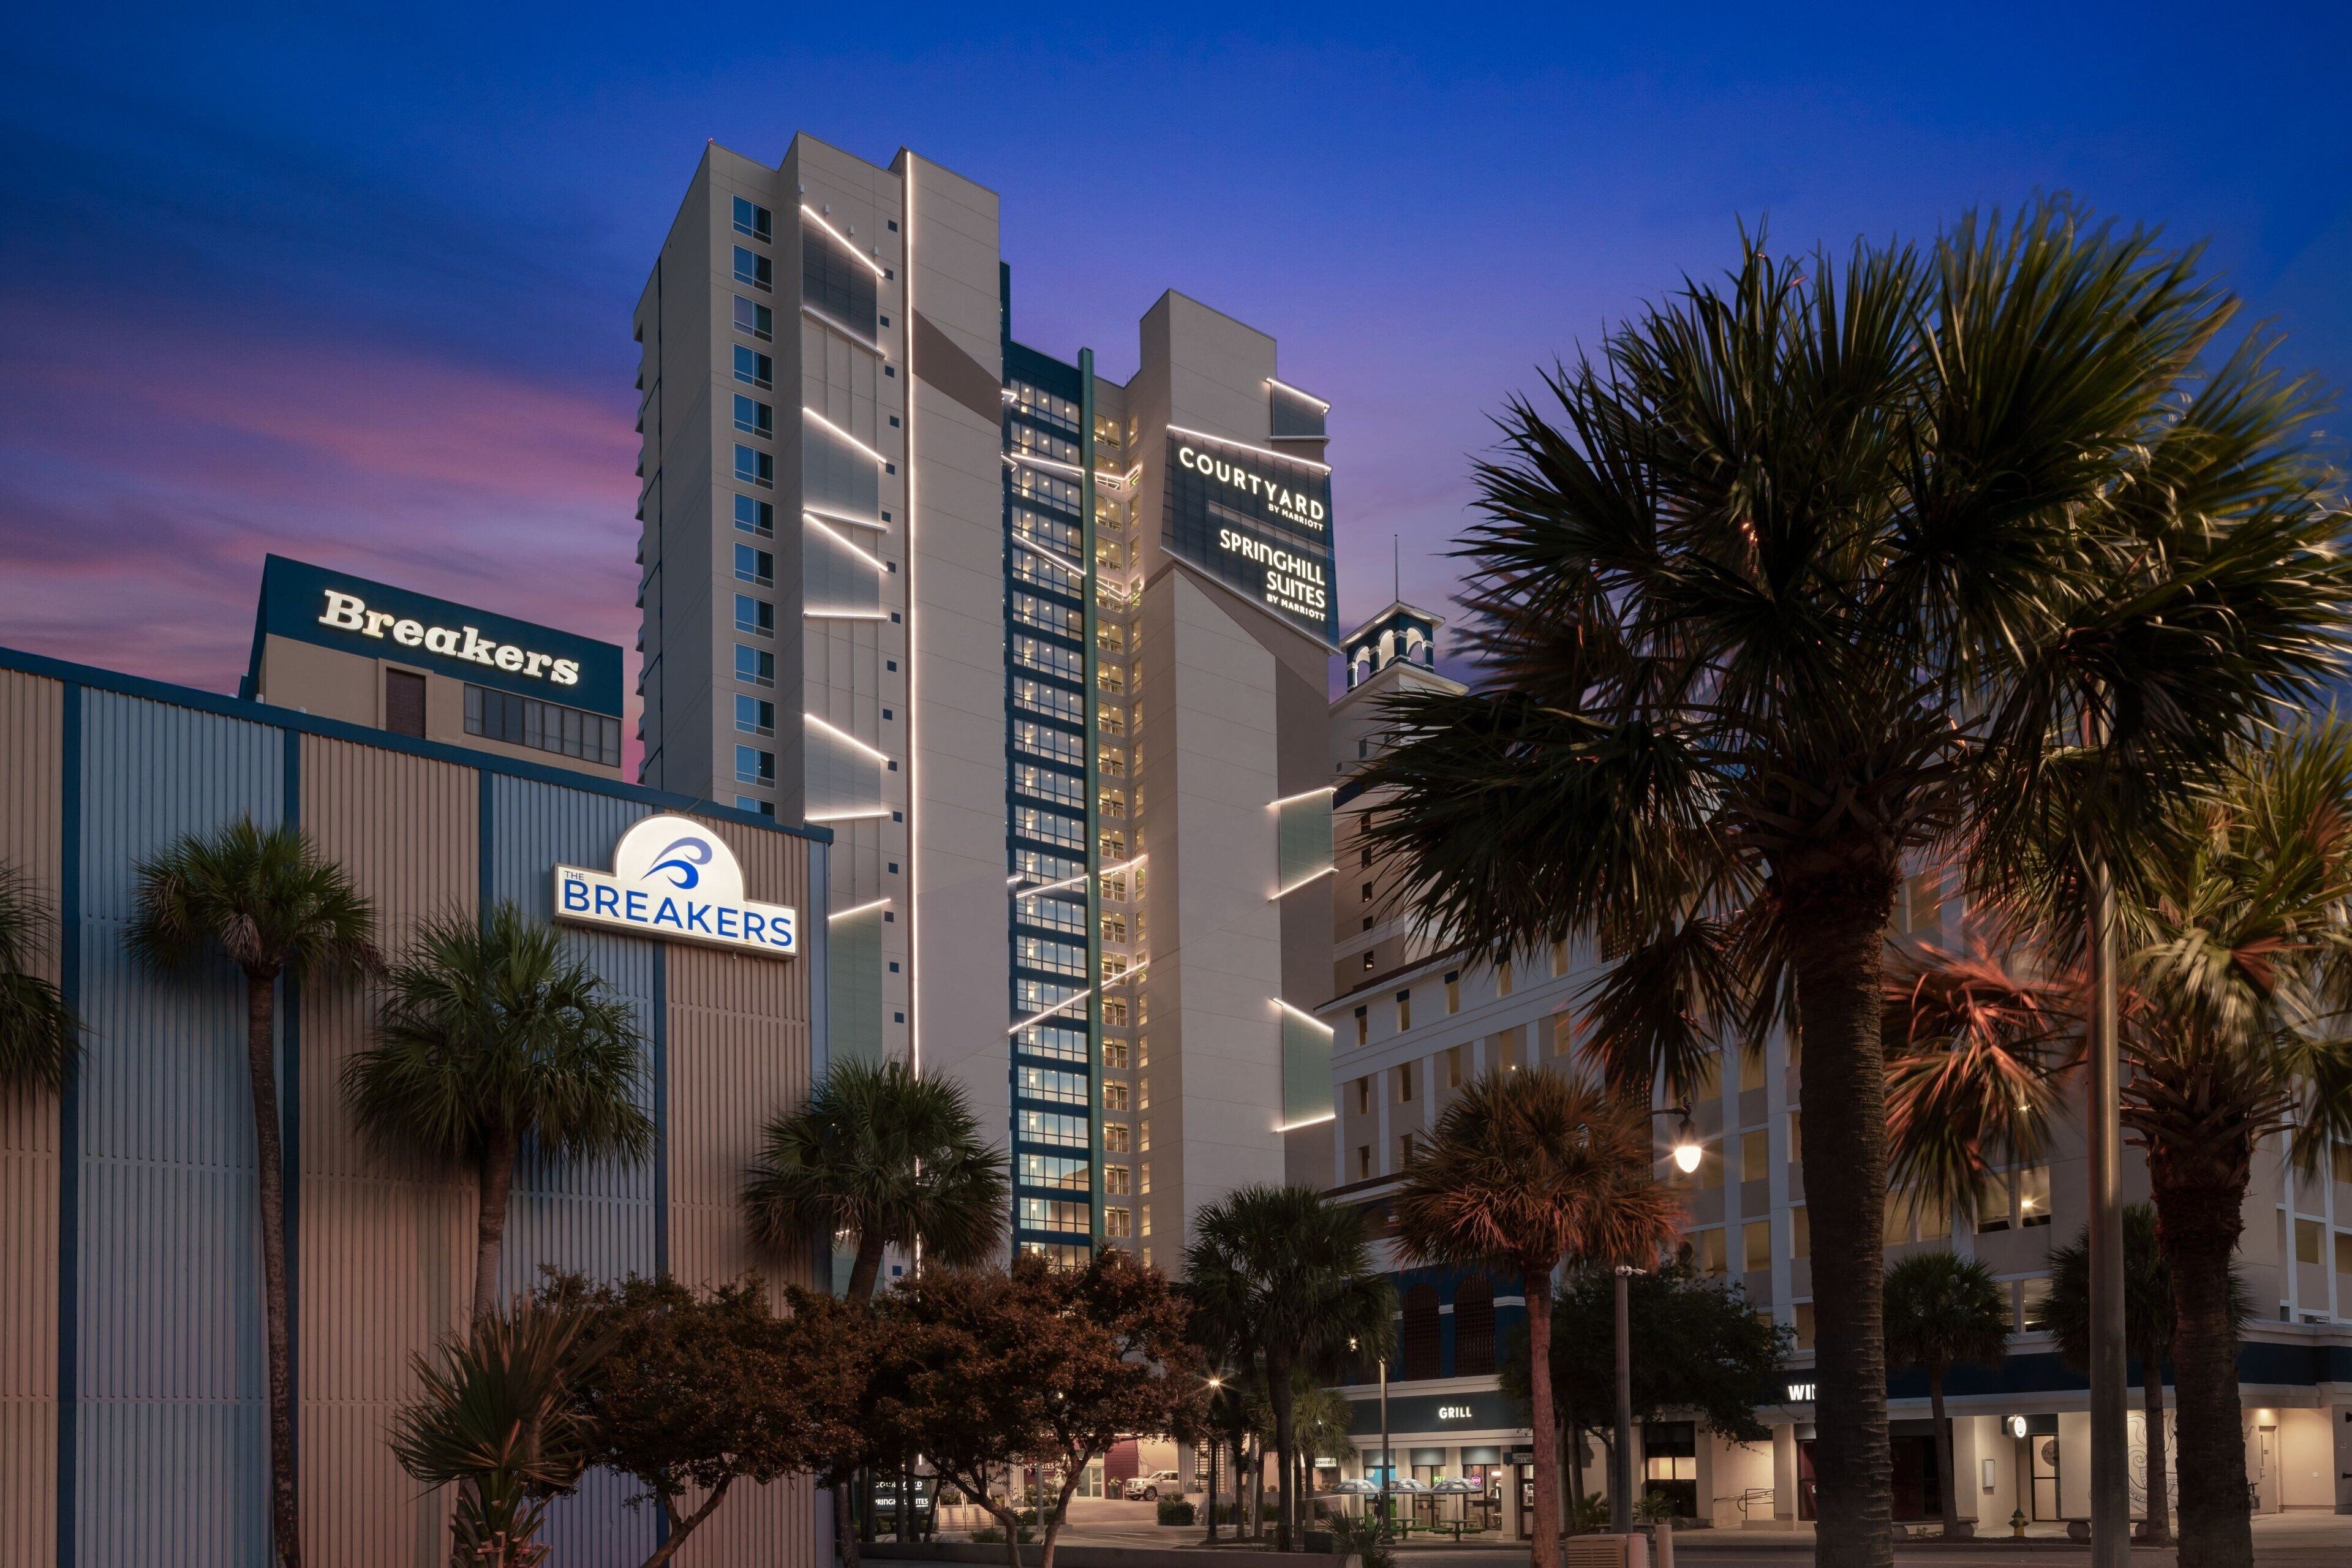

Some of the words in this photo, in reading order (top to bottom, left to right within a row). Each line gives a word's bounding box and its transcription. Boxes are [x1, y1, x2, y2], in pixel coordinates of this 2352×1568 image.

[1179, 447, 1324, 520] COURTYARD
[1268, 503, 1280, 513] BY
[1282, 510, 1323, 531] MARRIOTT
[1220, 529, 1325, 586] SPRINGHILL
[1267, 571, 1325, 608] SUITES
[1267, 594, 1278, 604] BY
[1281, 598, 1325, 621] MARRIOTT
[318, 589, 579, 687] Breakers
[564, 870, 584, 881] THE
[564, 879, 793, 947] BREAKERS
[1439, 1406, 1472, 1419] GRILL
